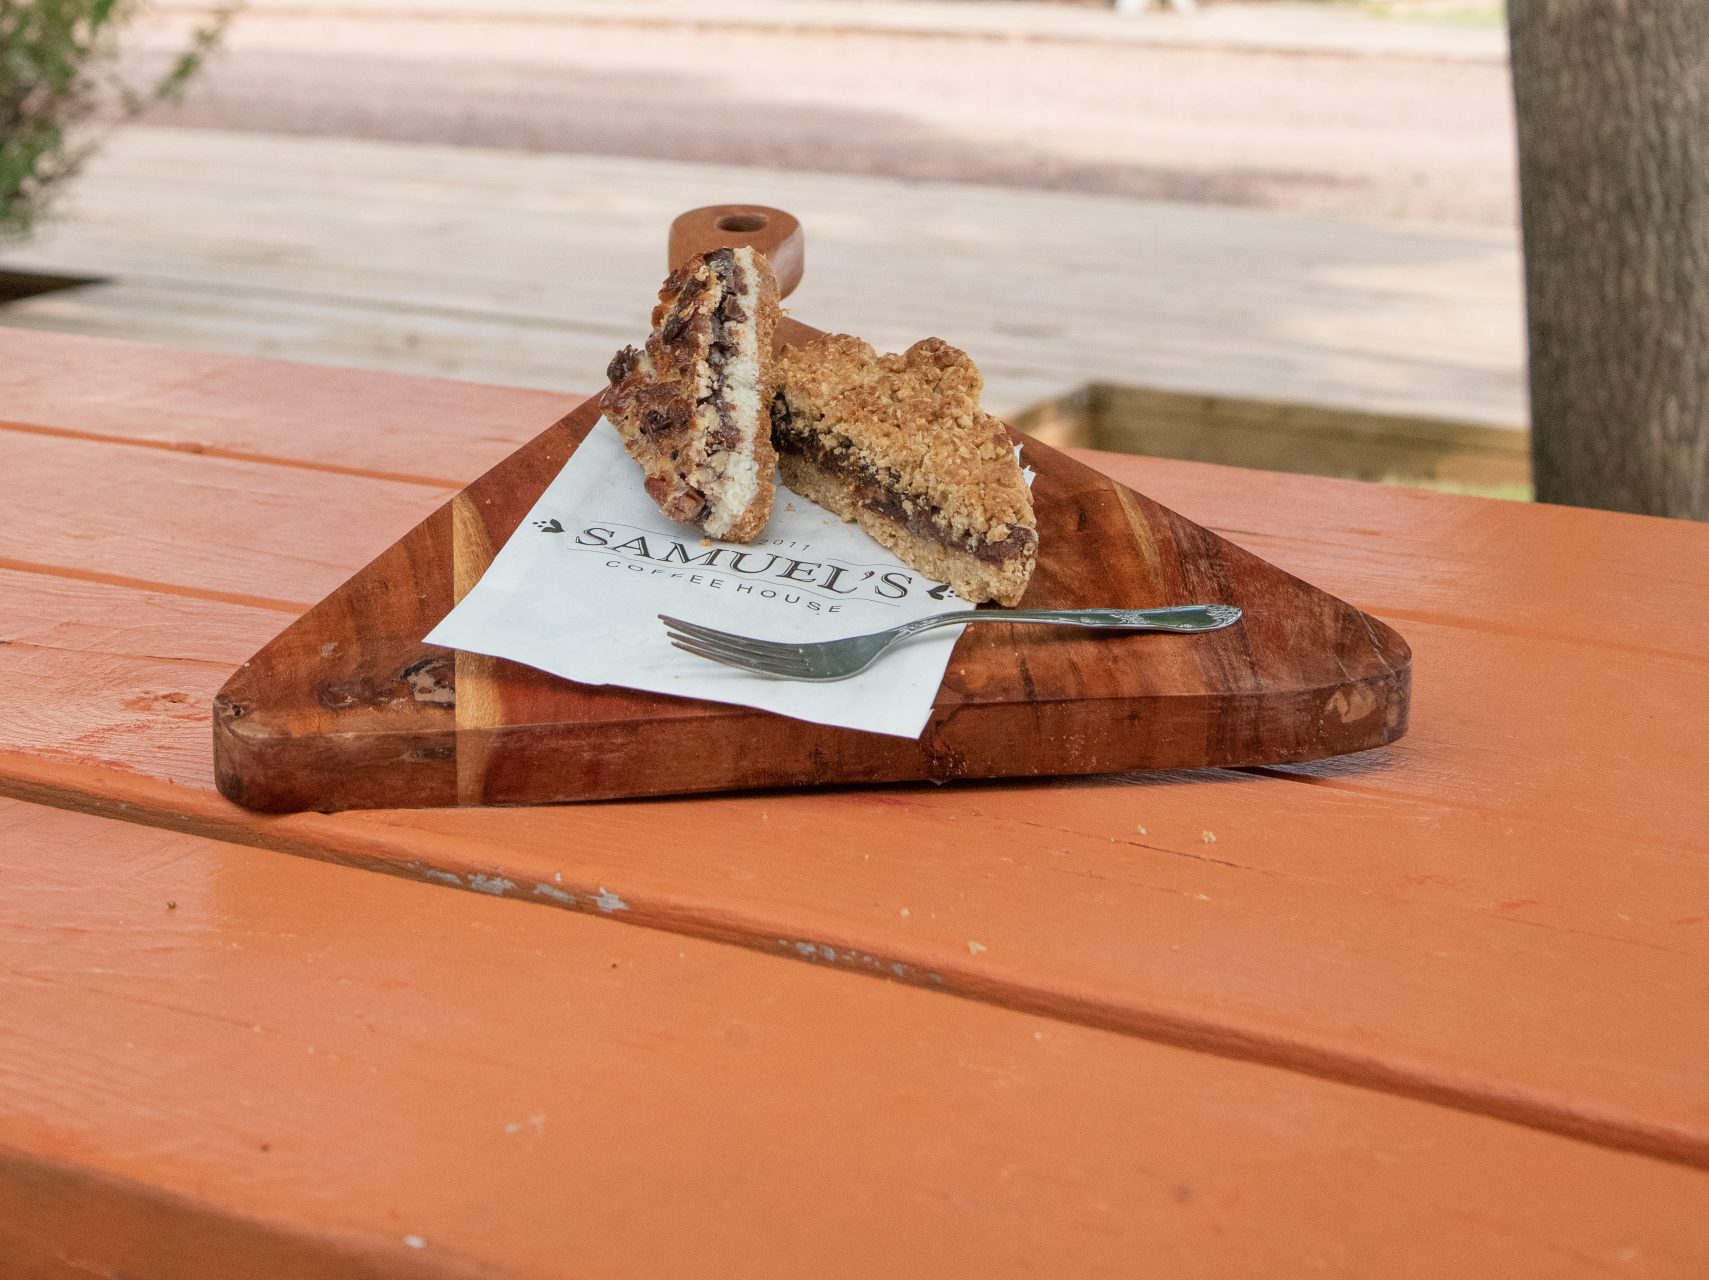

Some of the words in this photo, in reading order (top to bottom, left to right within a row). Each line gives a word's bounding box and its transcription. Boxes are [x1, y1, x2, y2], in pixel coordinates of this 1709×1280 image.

[574, 526, 913, 600] SAMUEL'S
[758, 538, 811, 552] 2011
[605, 560, 723, 589] COFFEE
[736, 583, 843, 613] HOUSE
